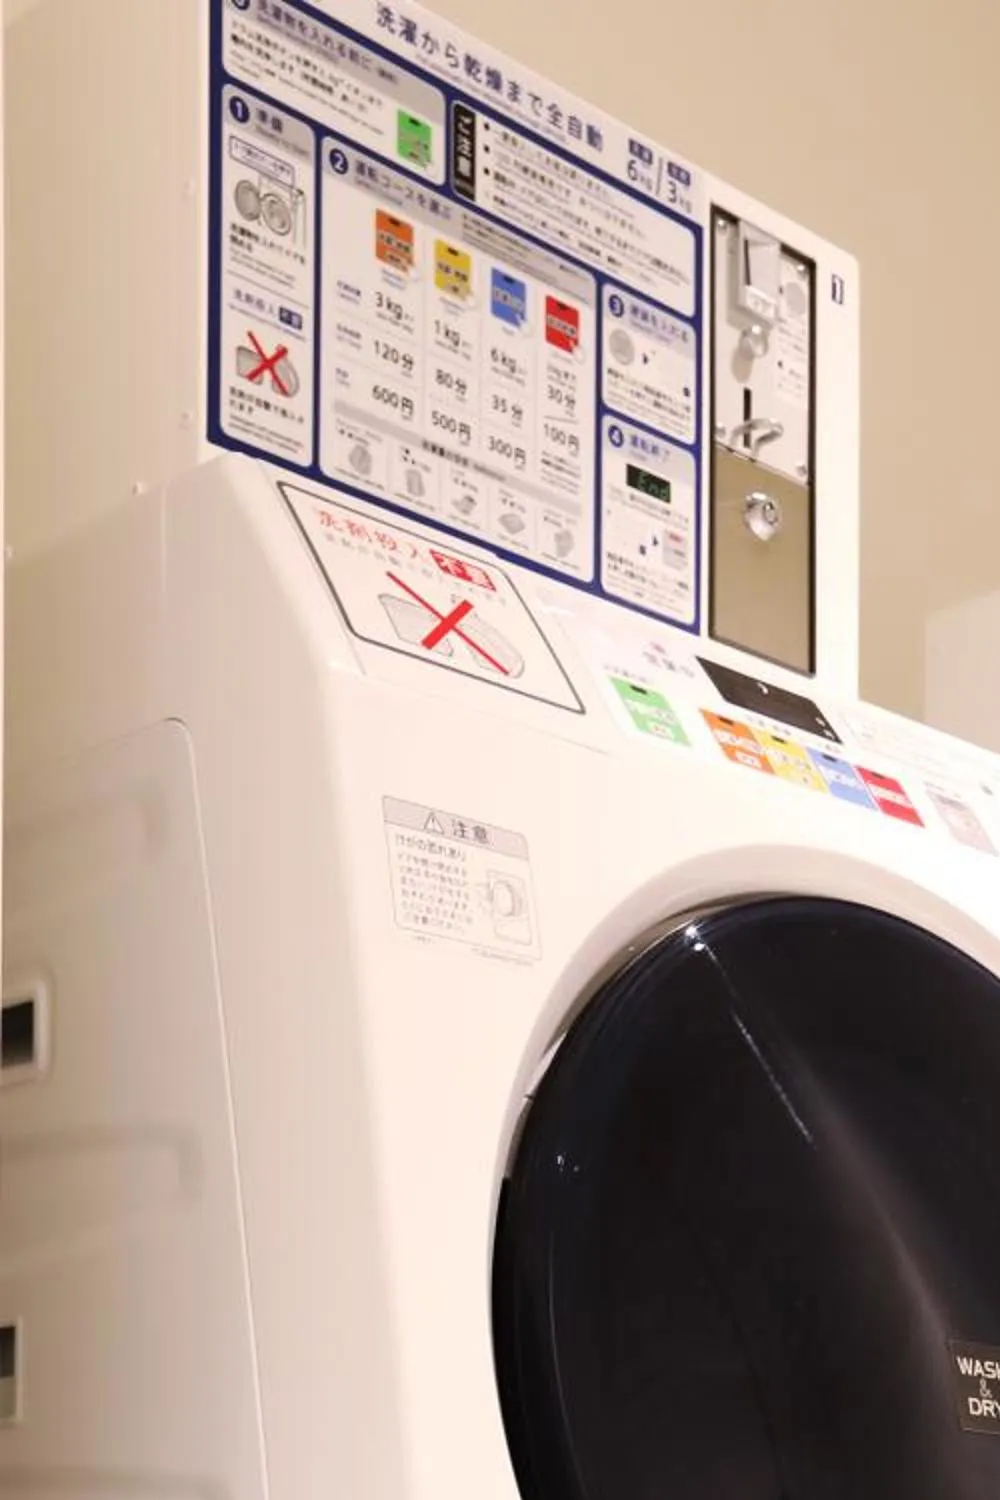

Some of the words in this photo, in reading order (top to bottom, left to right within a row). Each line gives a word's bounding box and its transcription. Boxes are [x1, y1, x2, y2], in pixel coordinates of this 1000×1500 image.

[376, 3, 603, 152] 洗濯から乾燥まで全自動
[980, 1379, 993, 1399] &
